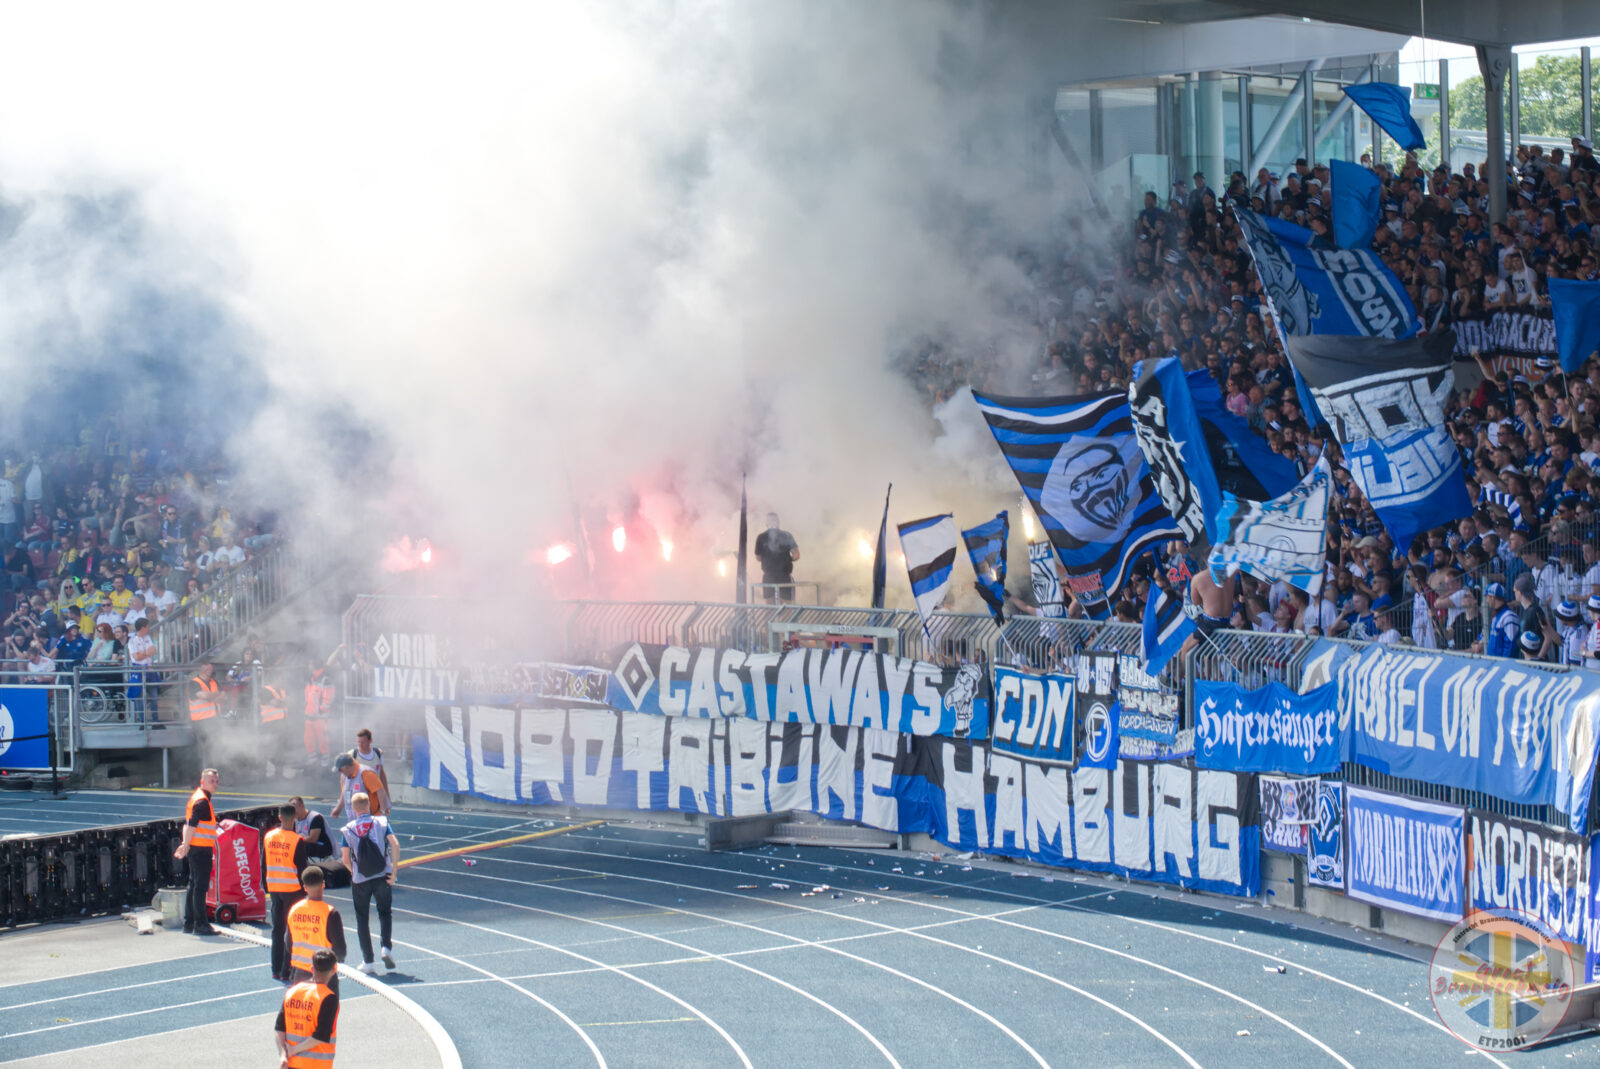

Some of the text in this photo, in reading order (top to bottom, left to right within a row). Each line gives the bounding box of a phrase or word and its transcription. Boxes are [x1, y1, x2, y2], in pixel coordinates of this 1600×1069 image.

[374, 666, 459, 701] LOYALTY
[658, 645, 943, 737] CASTAWAYS
[995, 675, 1072, 752] CDN
[1338, 647, 1583, 774] DANIEL ON TOUR
[1197, 695, 1338, 762] Hafensänger
[942, 742, 1241, 886] HAMBURG
[232, 837, 258, 902] SAFECADDY
[1352, 806, 1457, 903] NORDHAUSEN
[292, 913, 321, 925] ORDNER
[285, 999, 314, 1011] ORDNER
